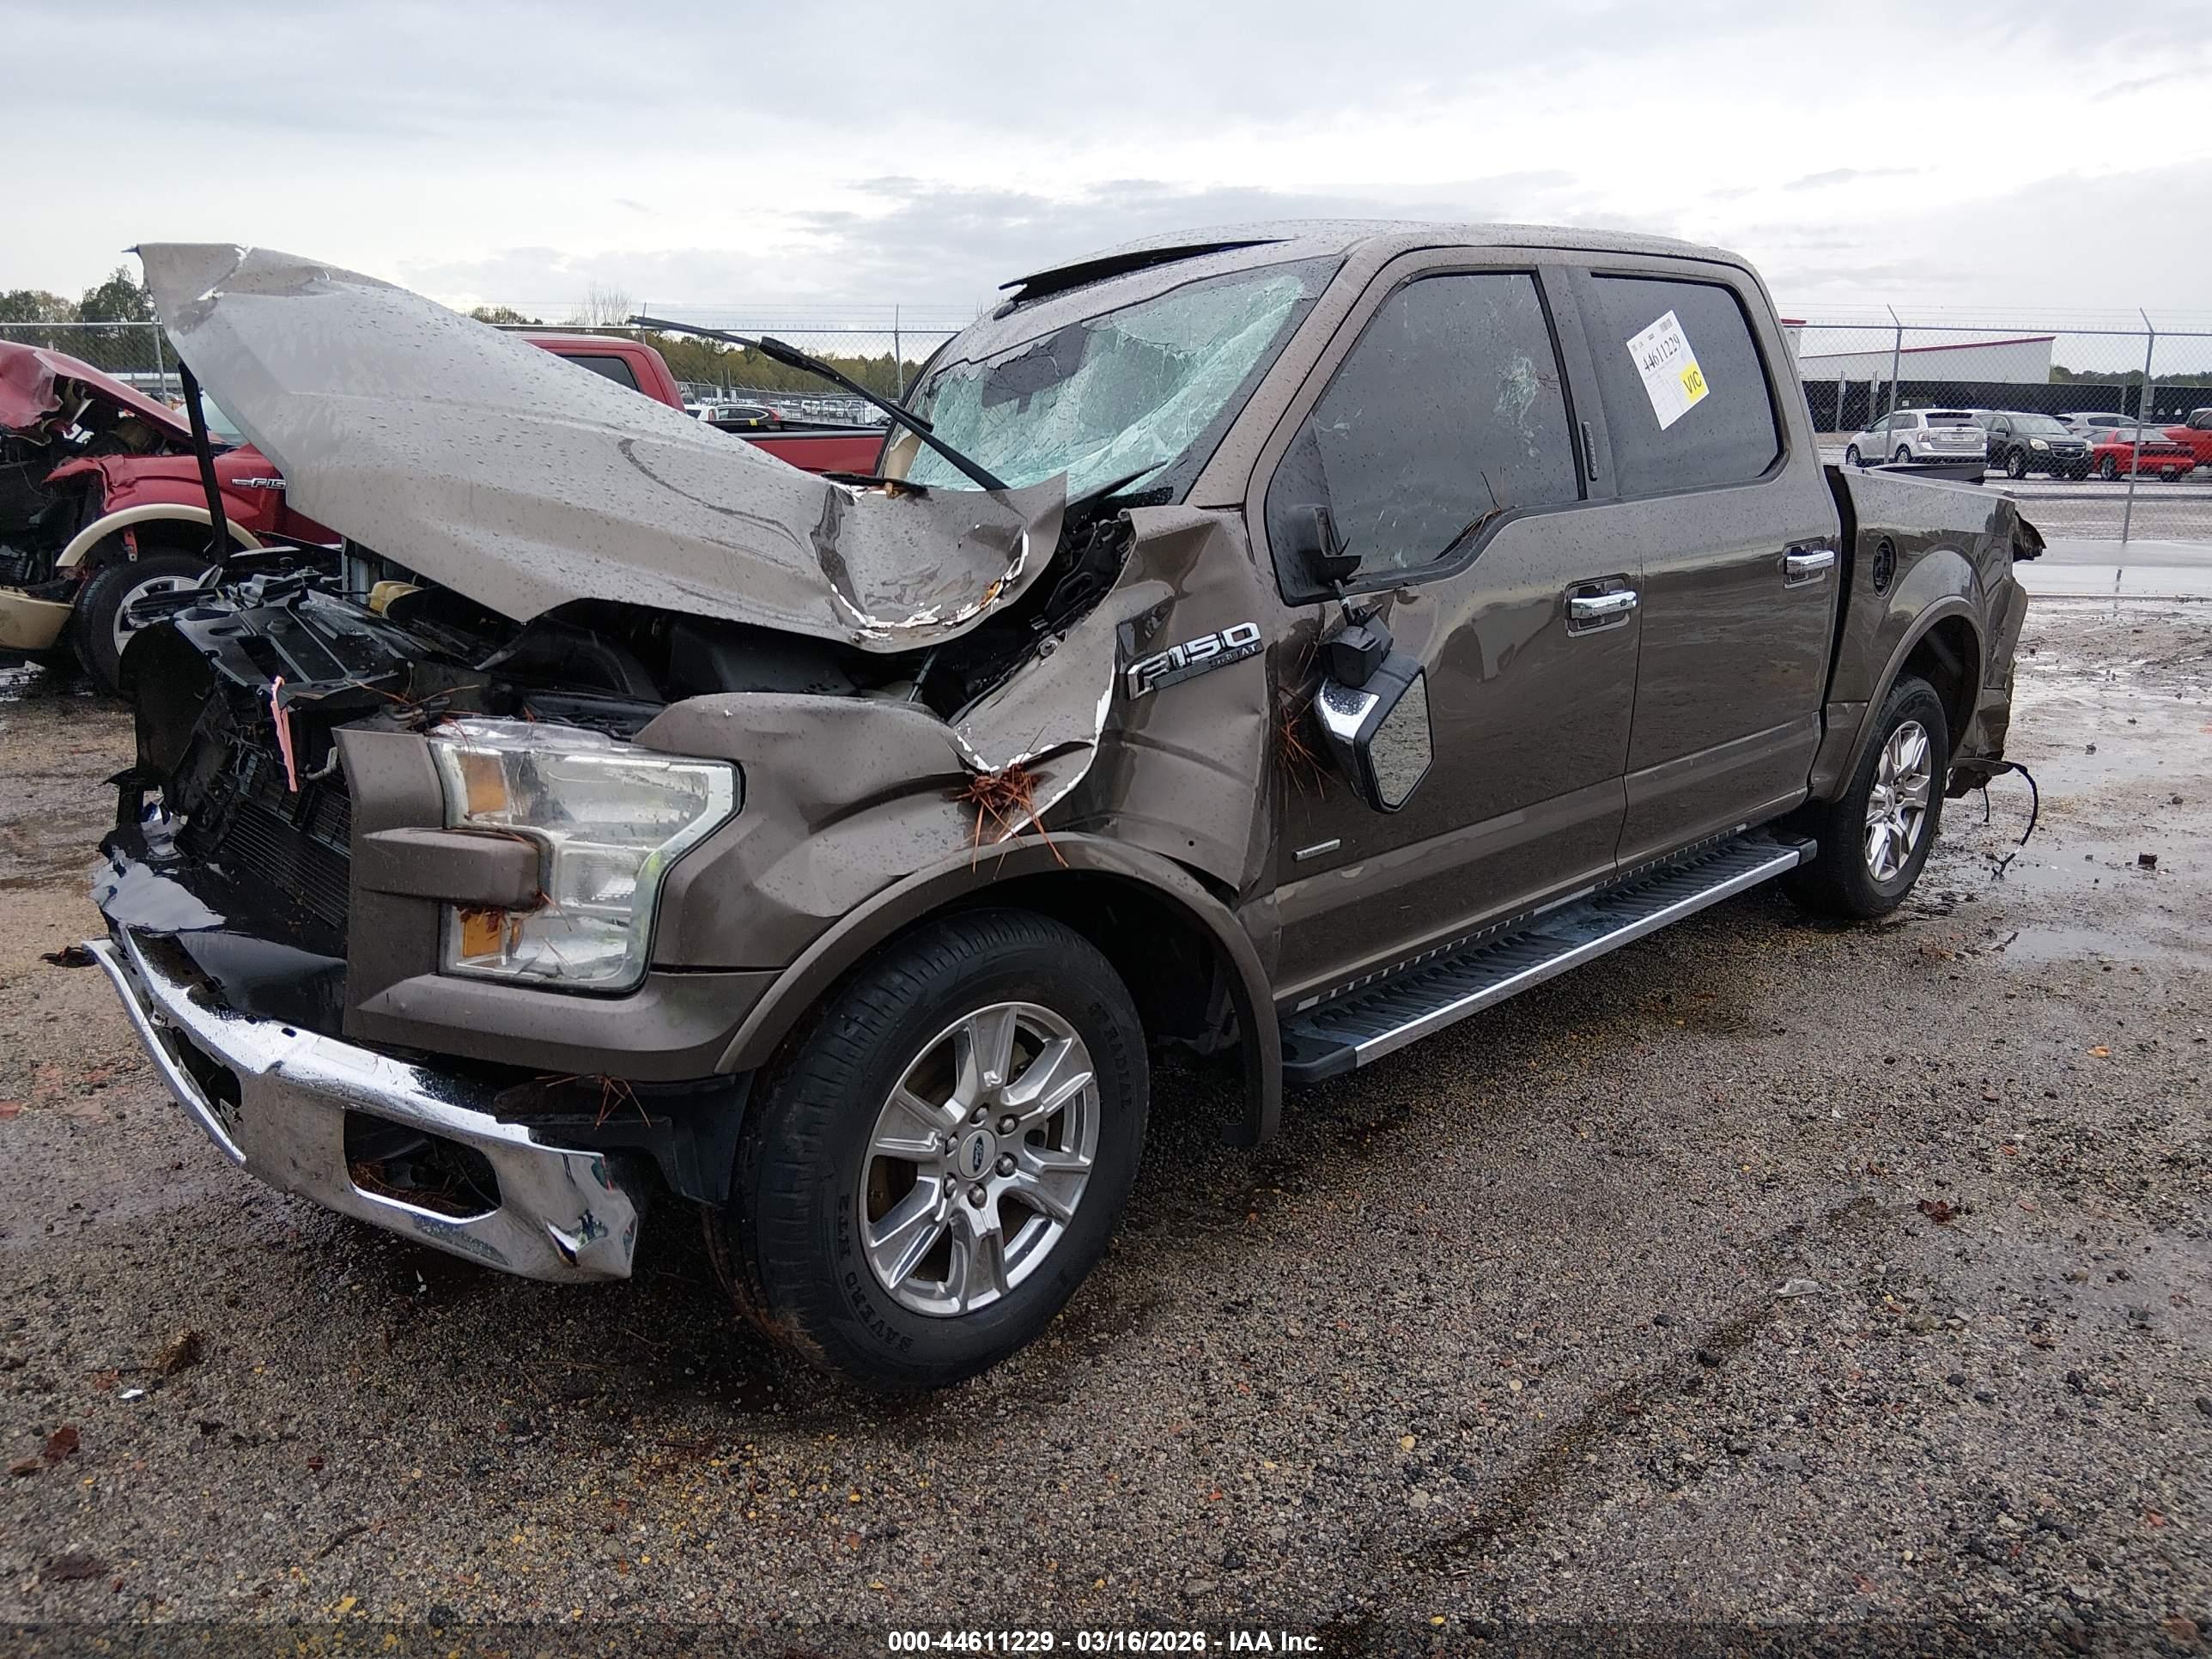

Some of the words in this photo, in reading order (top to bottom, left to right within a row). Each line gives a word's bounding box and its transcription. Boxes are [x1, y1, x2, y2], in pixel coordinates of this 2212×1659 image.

[1643, 333, 1681, 372] 44611229
[1683, 371, 1702, 394] VIC
[252, 477, 286, 489] F15
[844, 1271, 914, 1353] SAVERO
